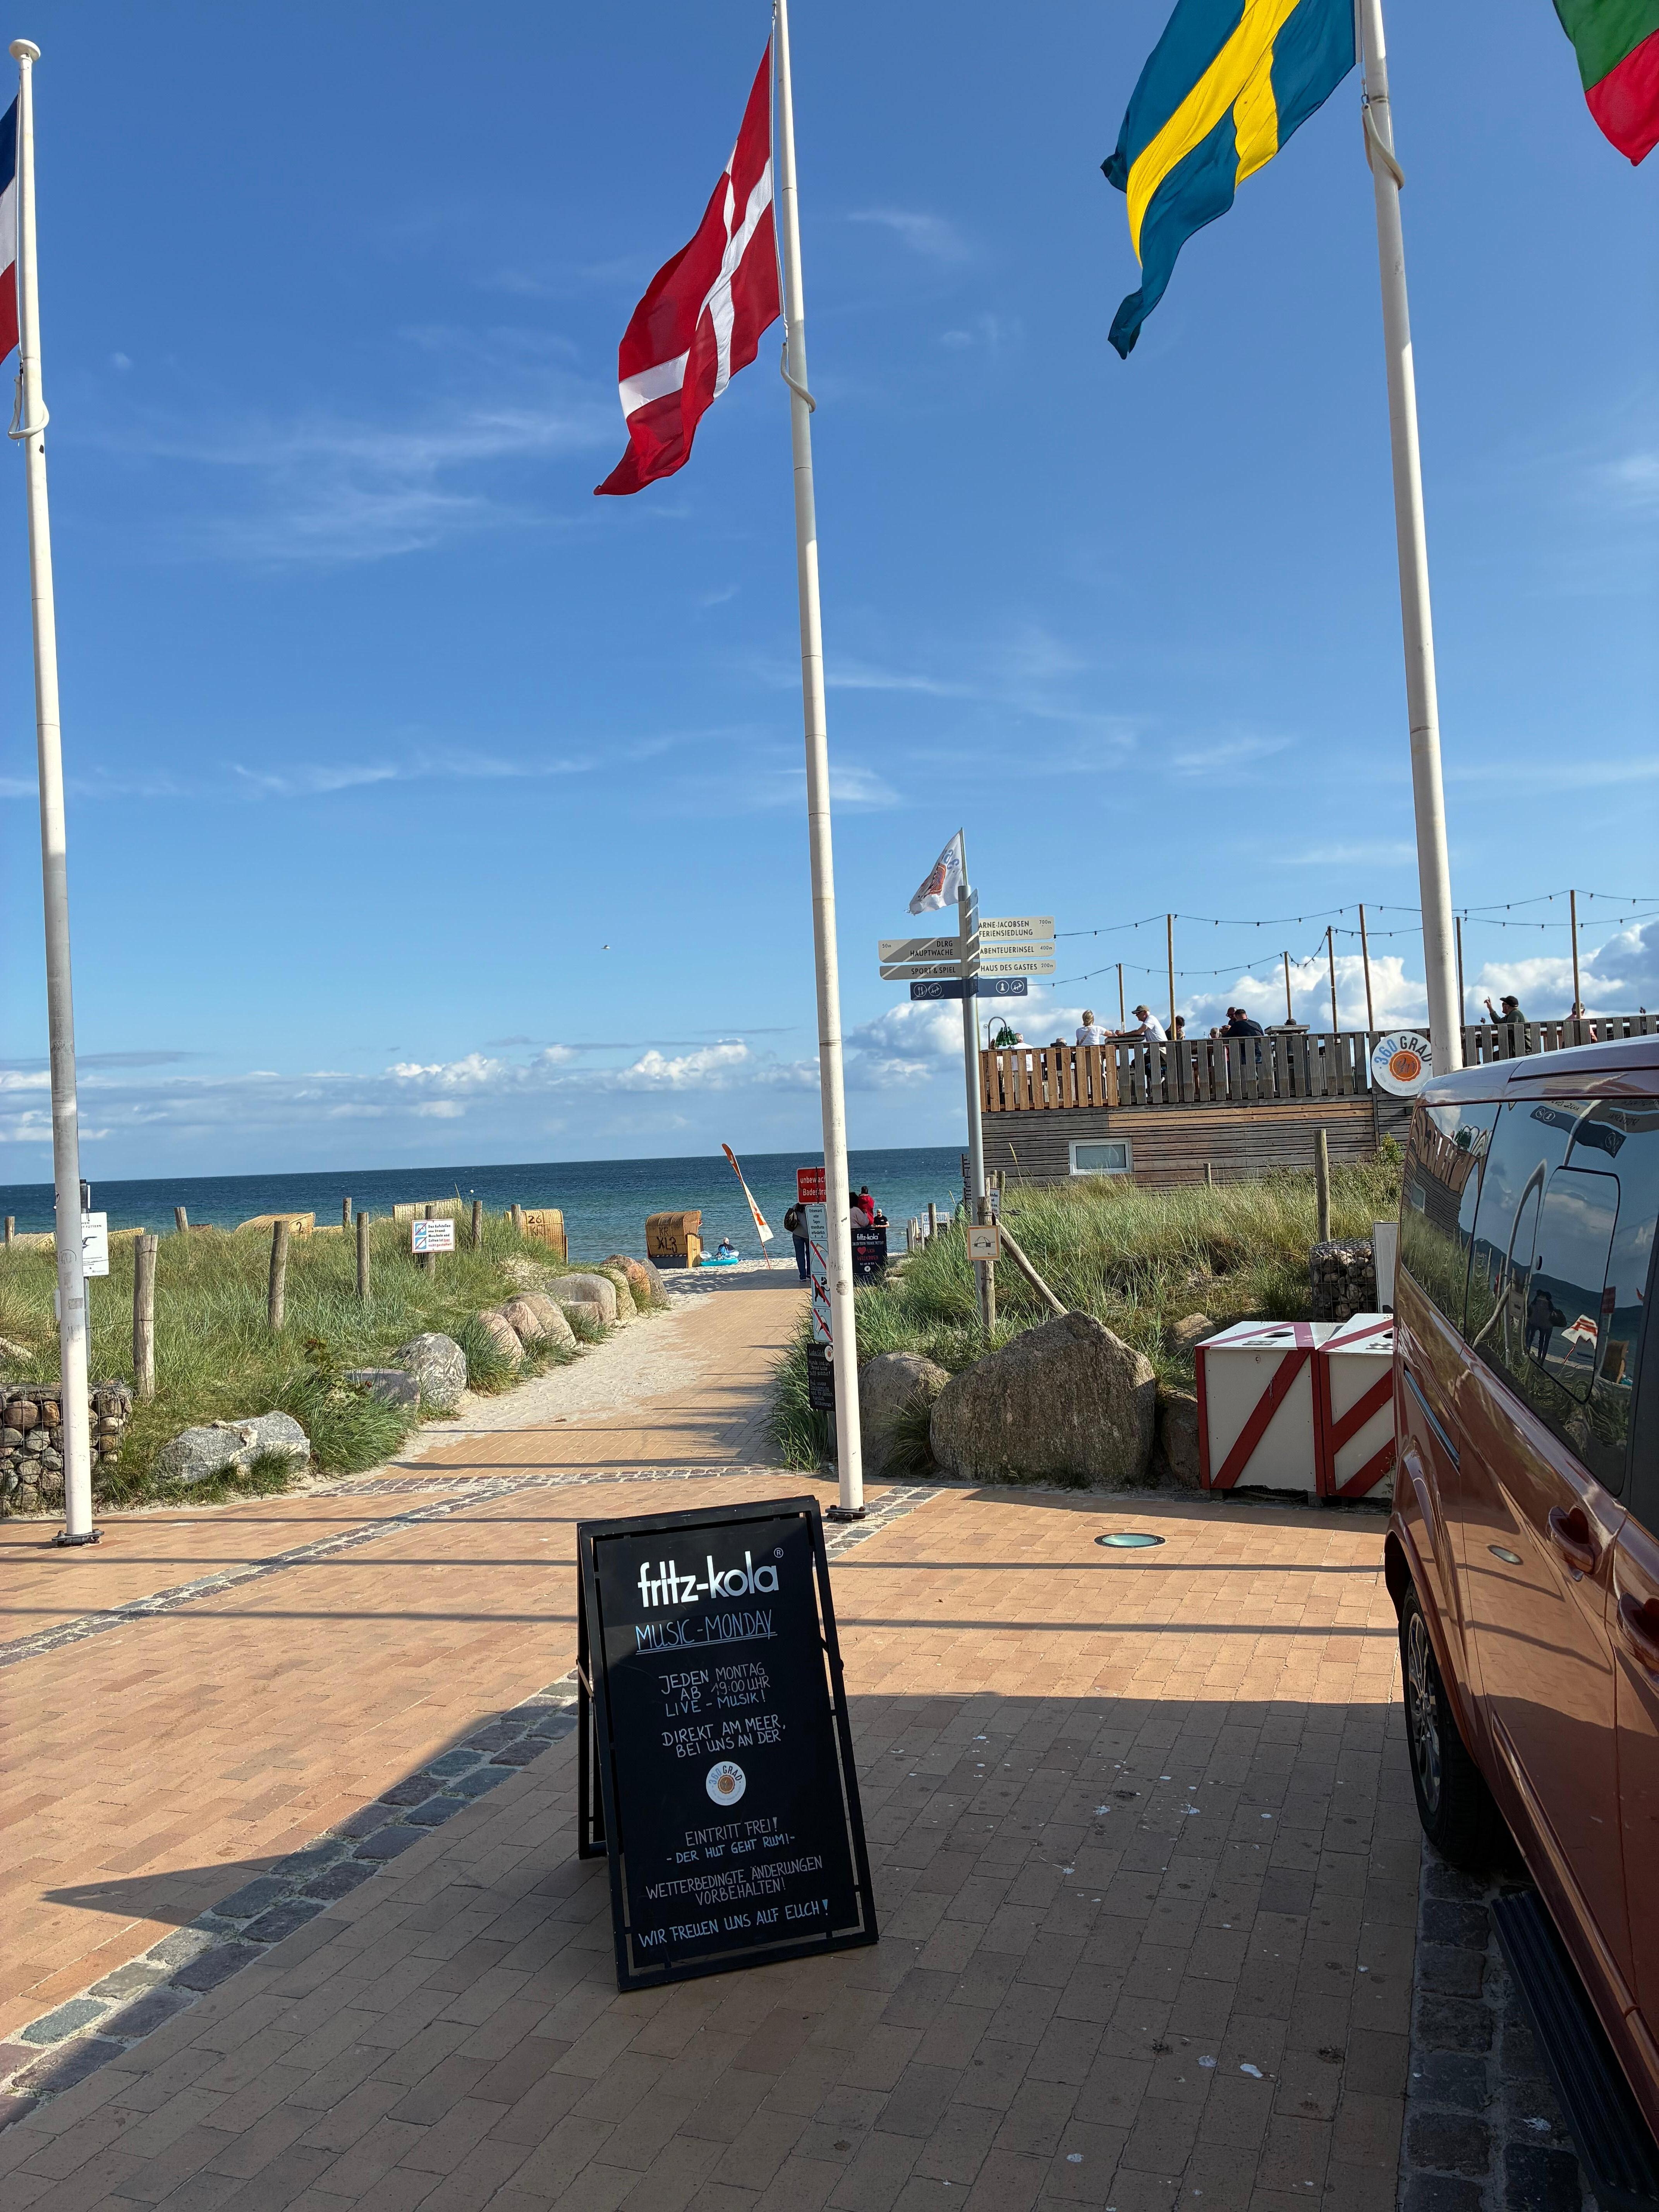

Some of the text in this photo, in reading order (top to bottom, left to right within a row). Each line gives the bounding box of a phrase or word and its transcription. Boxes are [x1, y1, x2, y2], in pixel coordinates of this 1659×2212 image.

[979, 921, 1029, 929] ARNE-JACOBSEN
[979, 929, 1033, 937] FERIENSIEDLUNG
[1374, 1036, 1432, 1065] 360 GRAD
[528, 1215, 542, 1223] 26
[658, 1662, 765, 1695] JEDEN MONTAG
[681, 1675, 771, 1701] AB 19:00 UHR
[666, 1700, 701, 1717] LIVE
[661, 1714, 786, 1746] DIREKT AM MEER,
[676, 1729, 781, 1757] BEI UNS AN DER
[709, 1765, 742, 1784] 360 GRAD
[685, 1817, 777, 1846] EINTRITT FREI!
[705, 1844, 725, 1858] HUT
[731, 1839, 757, 1853] GEHT
[646, 1855, 823, 1899] WETTERBEDINGTE ÄNDERUNGEN
[696, 1877, 786, 1906] VORBEHALTEN!
[638, 1929, 667, 1948] WIR
[669, 1919, 719, 1940] FREUEN
[724, 1914, 751, 1930] UNS
[757, 1908, 779, 1925] AUF
